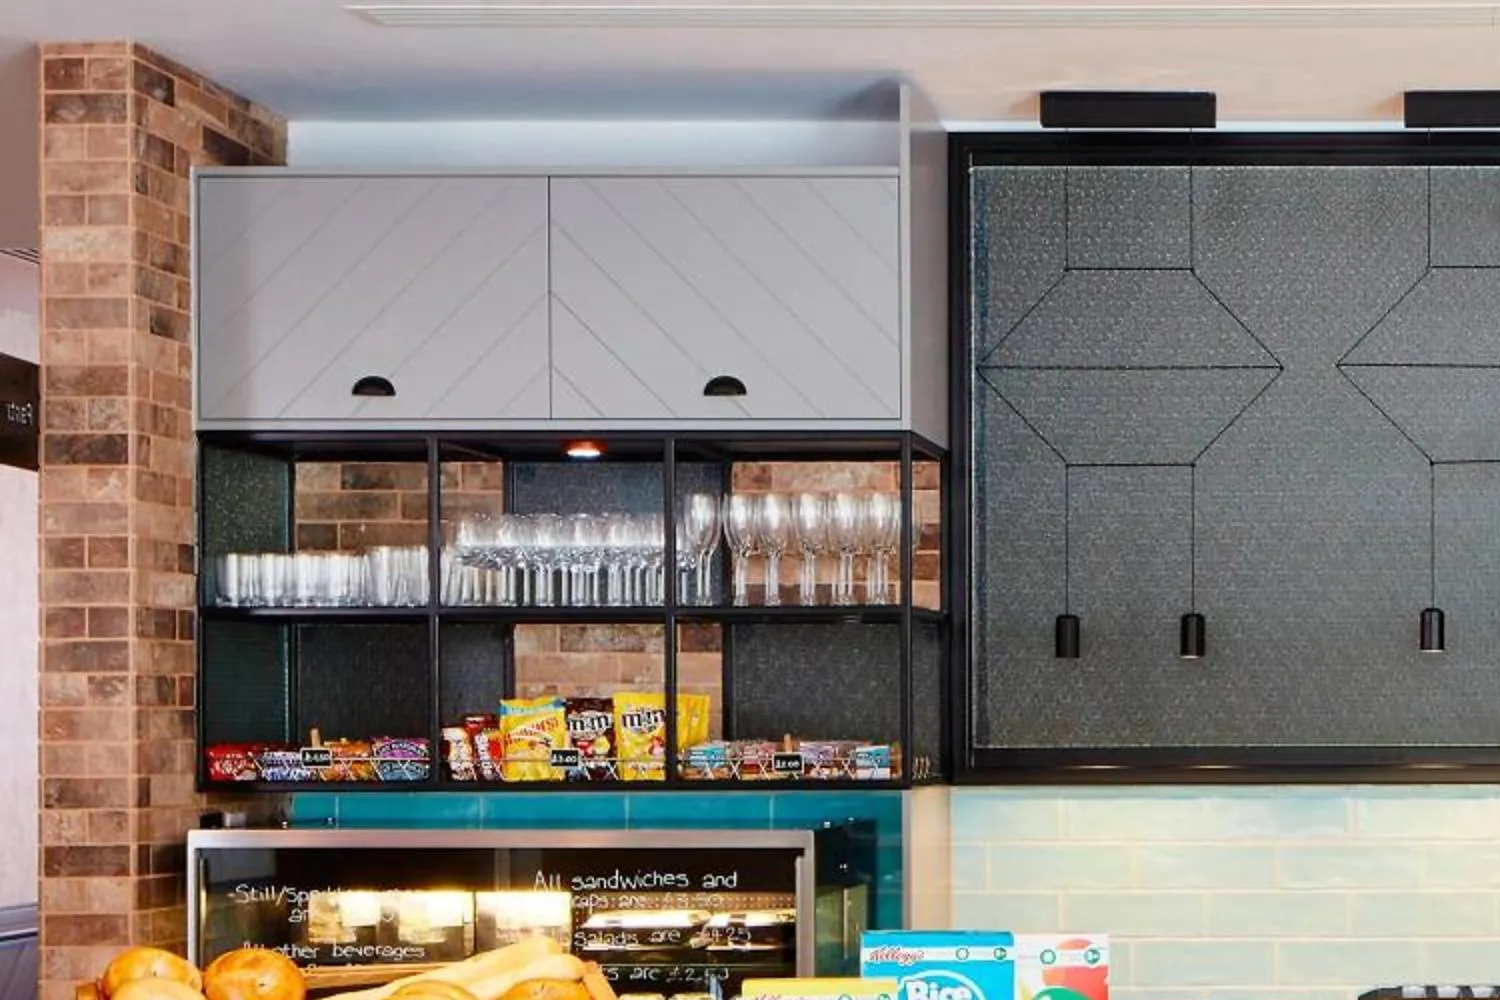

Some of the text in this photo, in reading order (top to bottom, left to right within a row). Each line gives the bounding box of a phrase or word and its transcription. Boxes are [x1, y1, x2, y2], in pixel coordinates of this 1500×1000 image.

[571, 869, 690, 891] sandwiches
[703, 871, 738, 888] and
[332, 942, 425, 961] beverages
